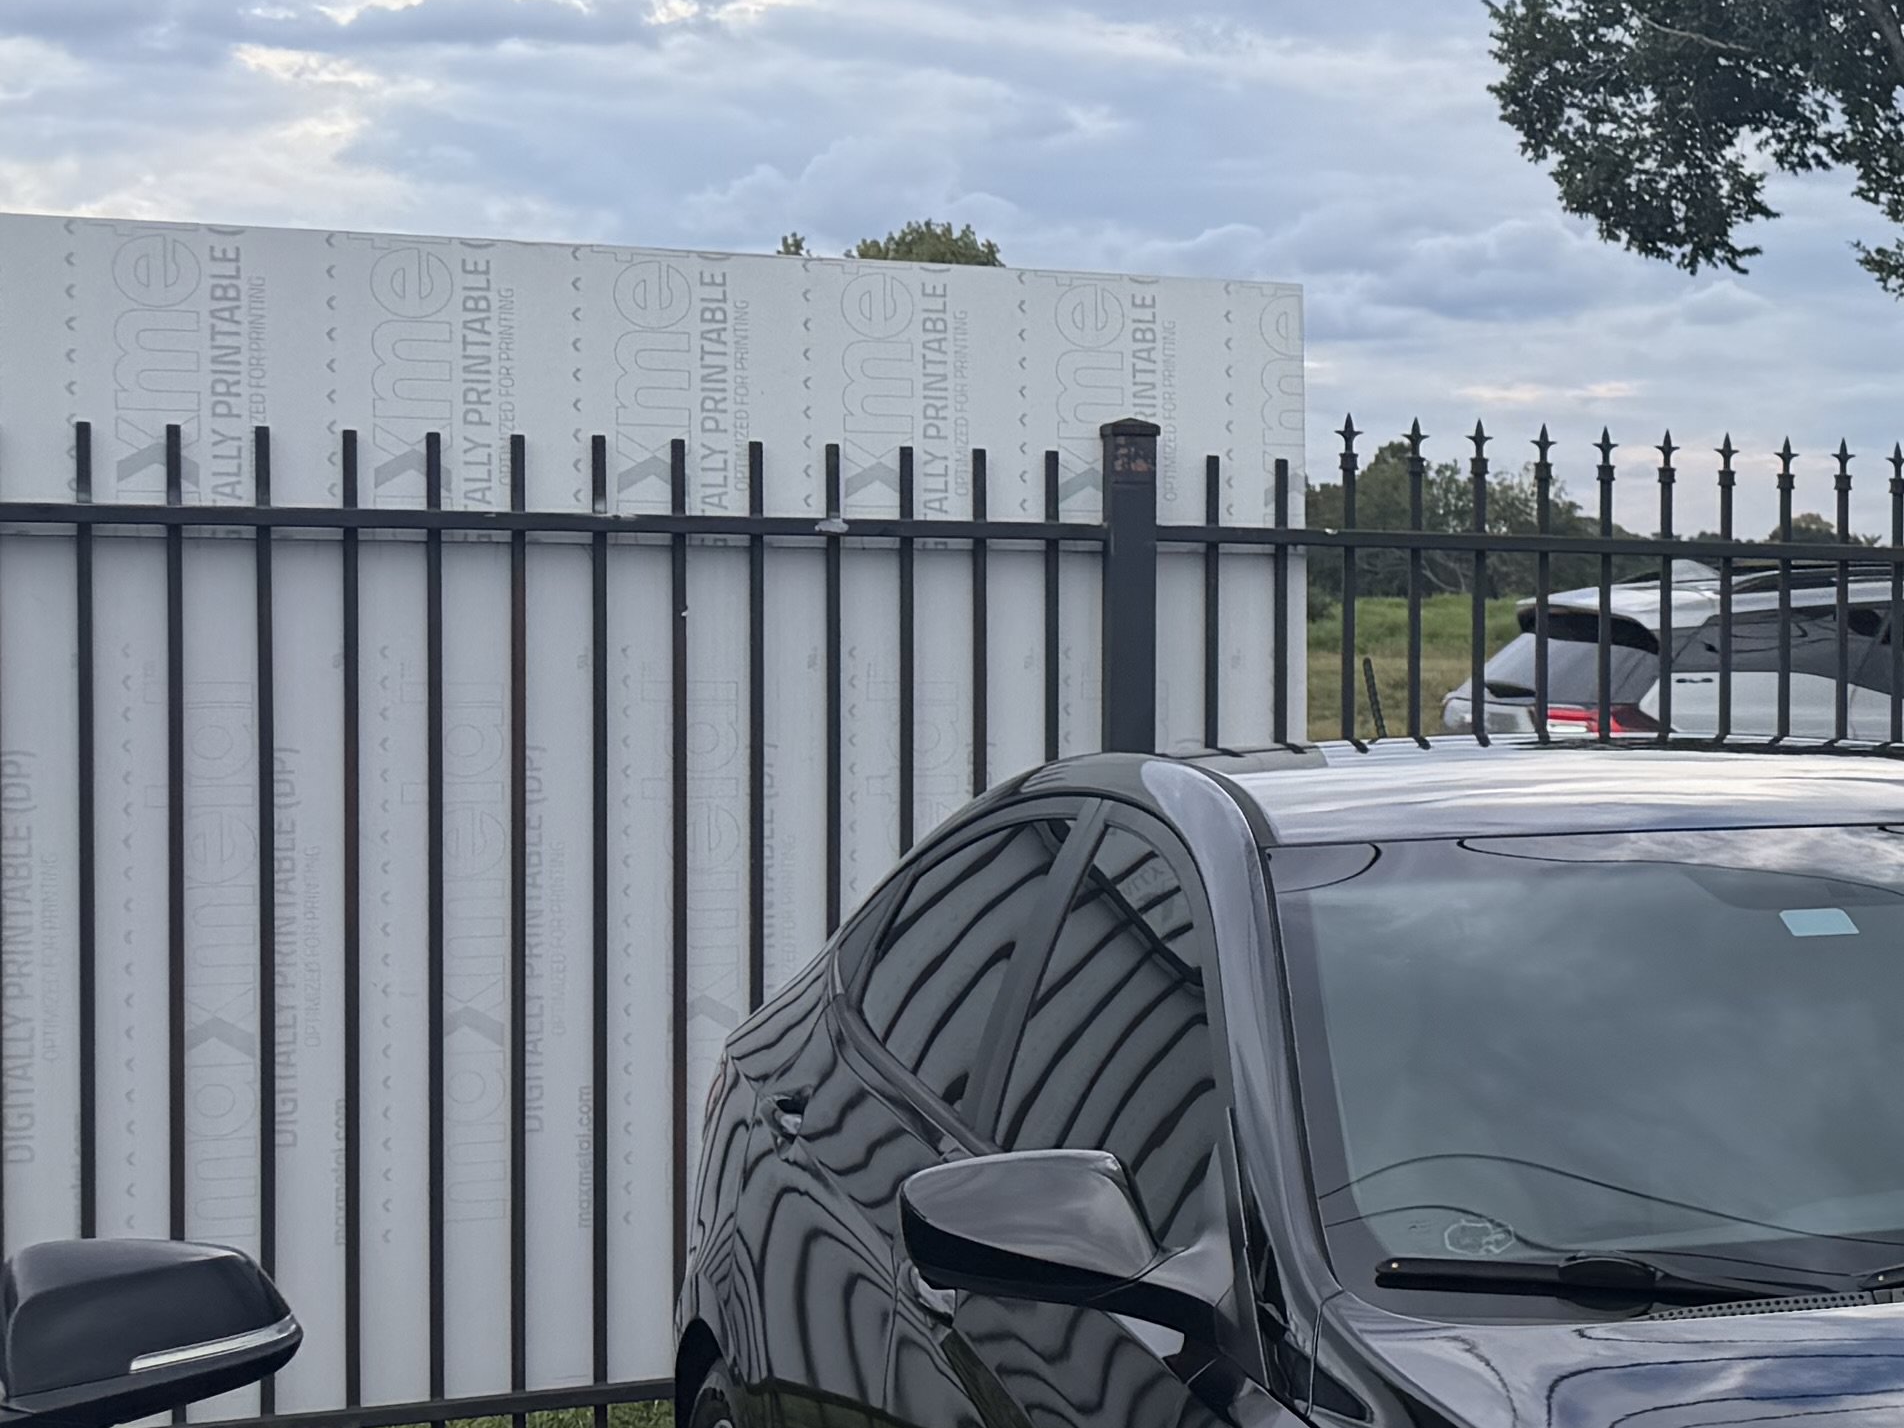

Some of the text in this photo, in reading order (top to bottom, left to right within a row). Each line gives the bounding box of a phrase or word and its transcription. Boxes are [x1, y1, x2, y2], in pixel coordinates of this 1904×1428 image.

[208, 244, 242, 419] PRINTABLE
[248, 275, 266, 352] PRINTING
[248, 356, 266, 388] FOR
[461, 258, 492, 427] PRINTABLE
[497, 287, 515, 362] PRINTING
[498, 366, 515, 397] FOR
[700, 271, 728, 434] PRINTABLE
[921, 283, 948, 440] PRINTABLE
[1131, 294, 1157, 420] RINTABLE
[210, 429, 242, 504] ALLY
[463, 436, 493, 510] ALLY
[733, 300, 750, 492] OPTIMIZED FOR PRINTING
[953, 310, 969, 497] OPTIMIZED FOR PRINTING
[1161, 321, 1178, 502] OPTIMIZED FOR PRINTING
[701, 444, 729, 516] ALLY
[922, 451, 949, 520] ALLY
[2, 748, 38, 1164] DIGITALLY PRINTABLE (DP)
[40, 853, 60, 1062] OPTIMIZED FOR PRINTING
[273, 745, 301, 1150] DIGITALLY PRINTABLE (DP)
[303, 845, 323, 1049] OPTIMIZED FOR PRINTING
[523, 815, 545, 980] PRINTABLE
[548, 842, 567, 1036] OPTIMIZED FOR PRINTING
[573, 1085, 594, 1229] maxmetal.com
